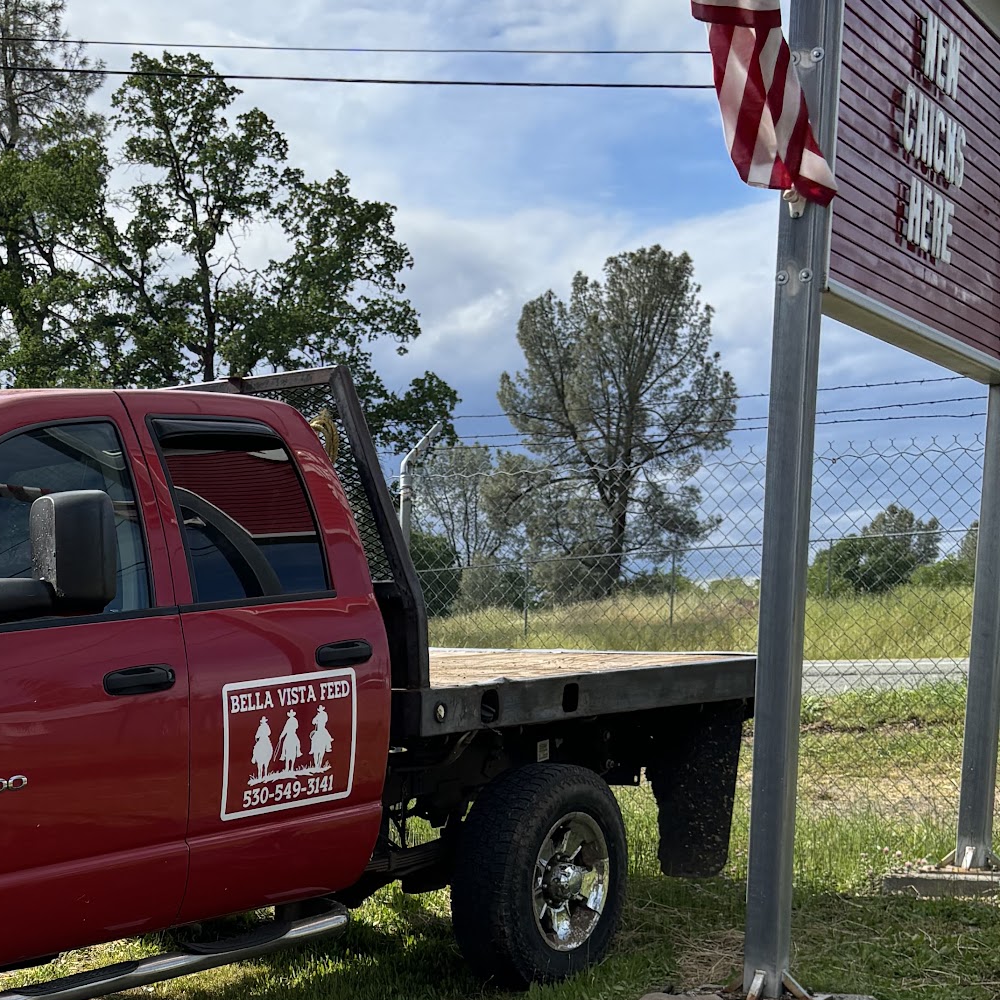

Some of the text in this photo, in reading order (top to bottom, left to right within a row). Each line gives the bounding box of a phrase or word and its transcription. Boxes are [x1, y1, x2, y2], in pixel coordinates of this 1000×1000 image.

[907, 176, 954, 264] HERE
[230, 680, 350, 714] BELLA VISTA FEED
[242, 774, 334, 808] 530-549-3141
